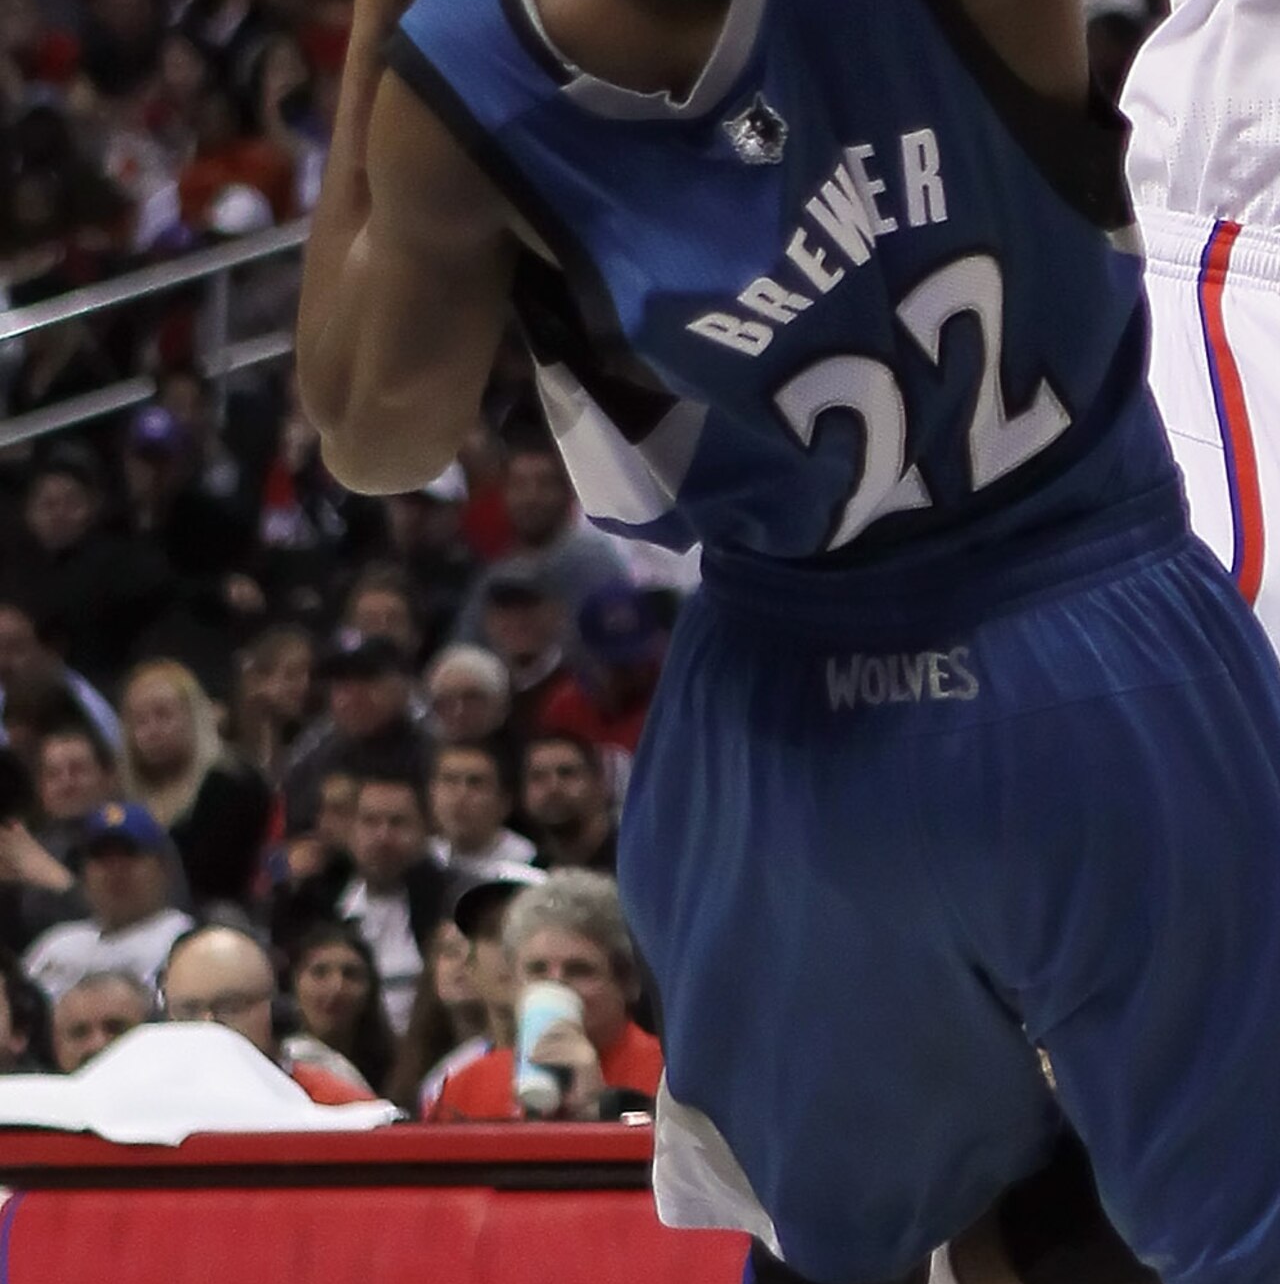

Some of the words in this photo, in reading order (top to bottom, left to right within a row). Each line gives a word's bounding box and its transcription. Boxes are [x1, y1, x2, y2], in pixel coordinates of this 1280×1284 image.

[686, 127, 949, 358] BREWER
[773, 253, 1073, 553] 22
[825, 644, 980, 710] WOLVES
